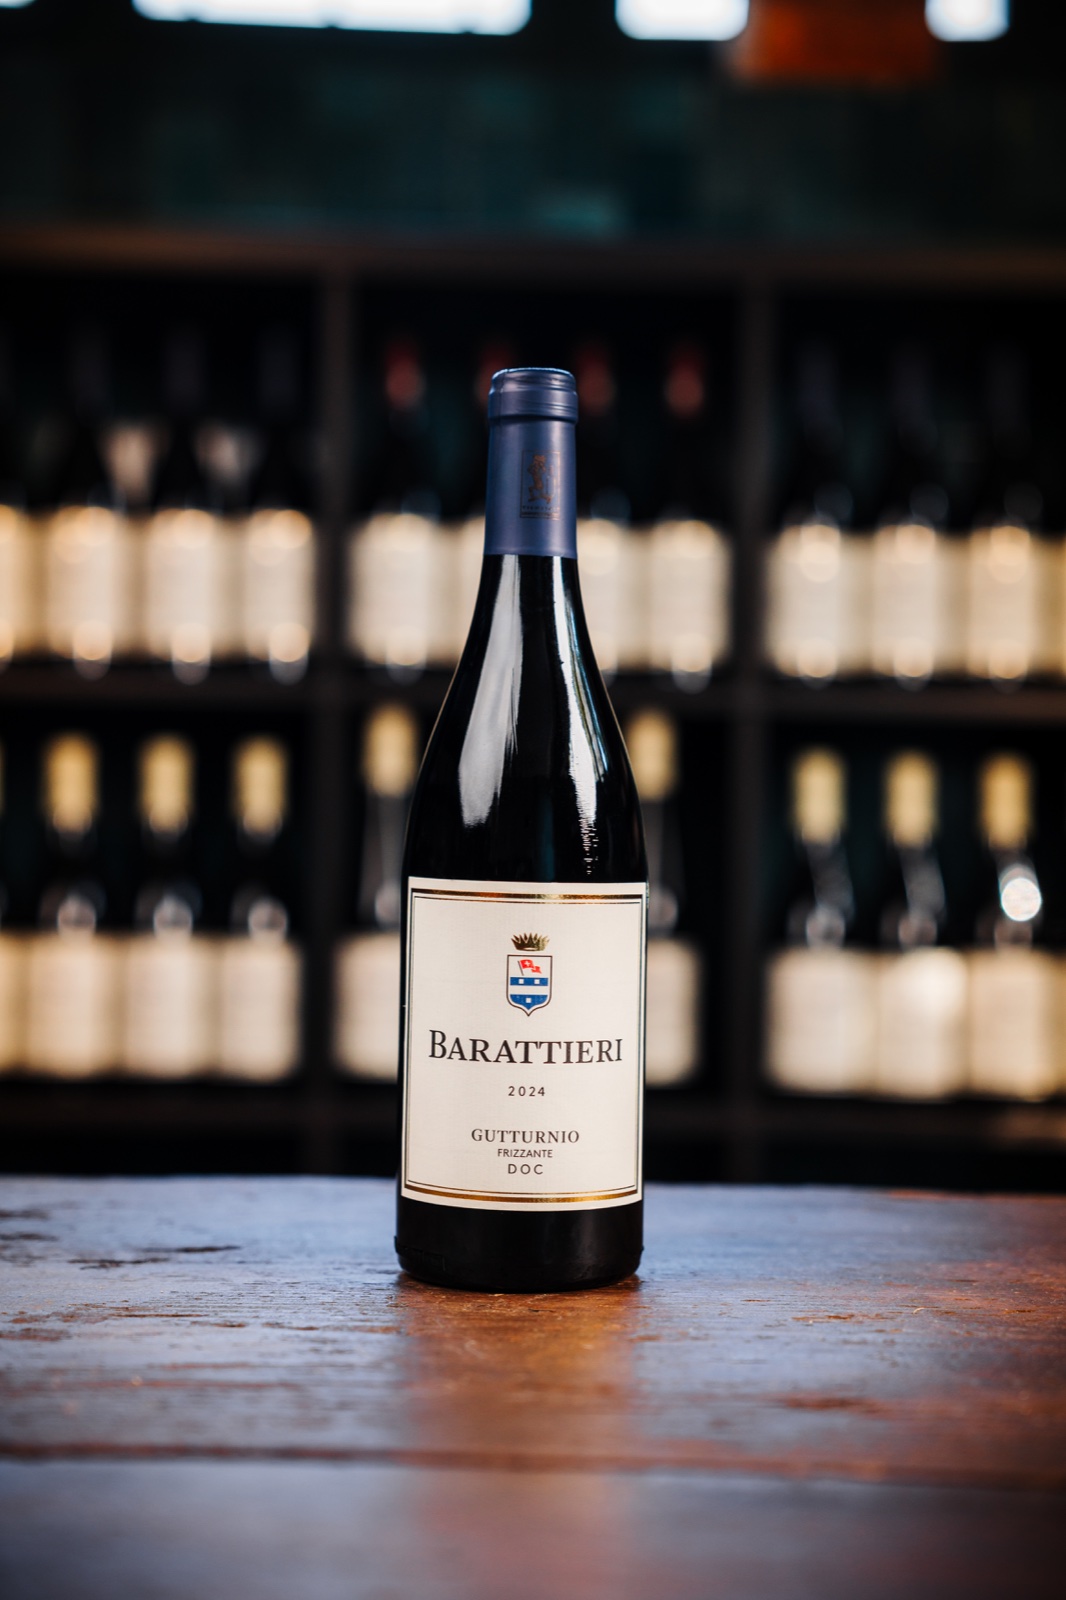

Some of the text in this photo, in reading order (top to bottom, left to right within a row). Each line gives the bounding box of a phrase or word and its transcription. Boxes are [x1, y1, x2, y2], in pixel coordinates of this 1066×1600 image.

[428, 1029, 623, 1064] BARATTIERI
[508, 1085, 545, 1097] 2024
[471, 1128, 580, 1143] GUTTURNIO
[497, 1148, 553, 1158] FRIZZANTE
[507, 1163, 544, 1175] DOC
